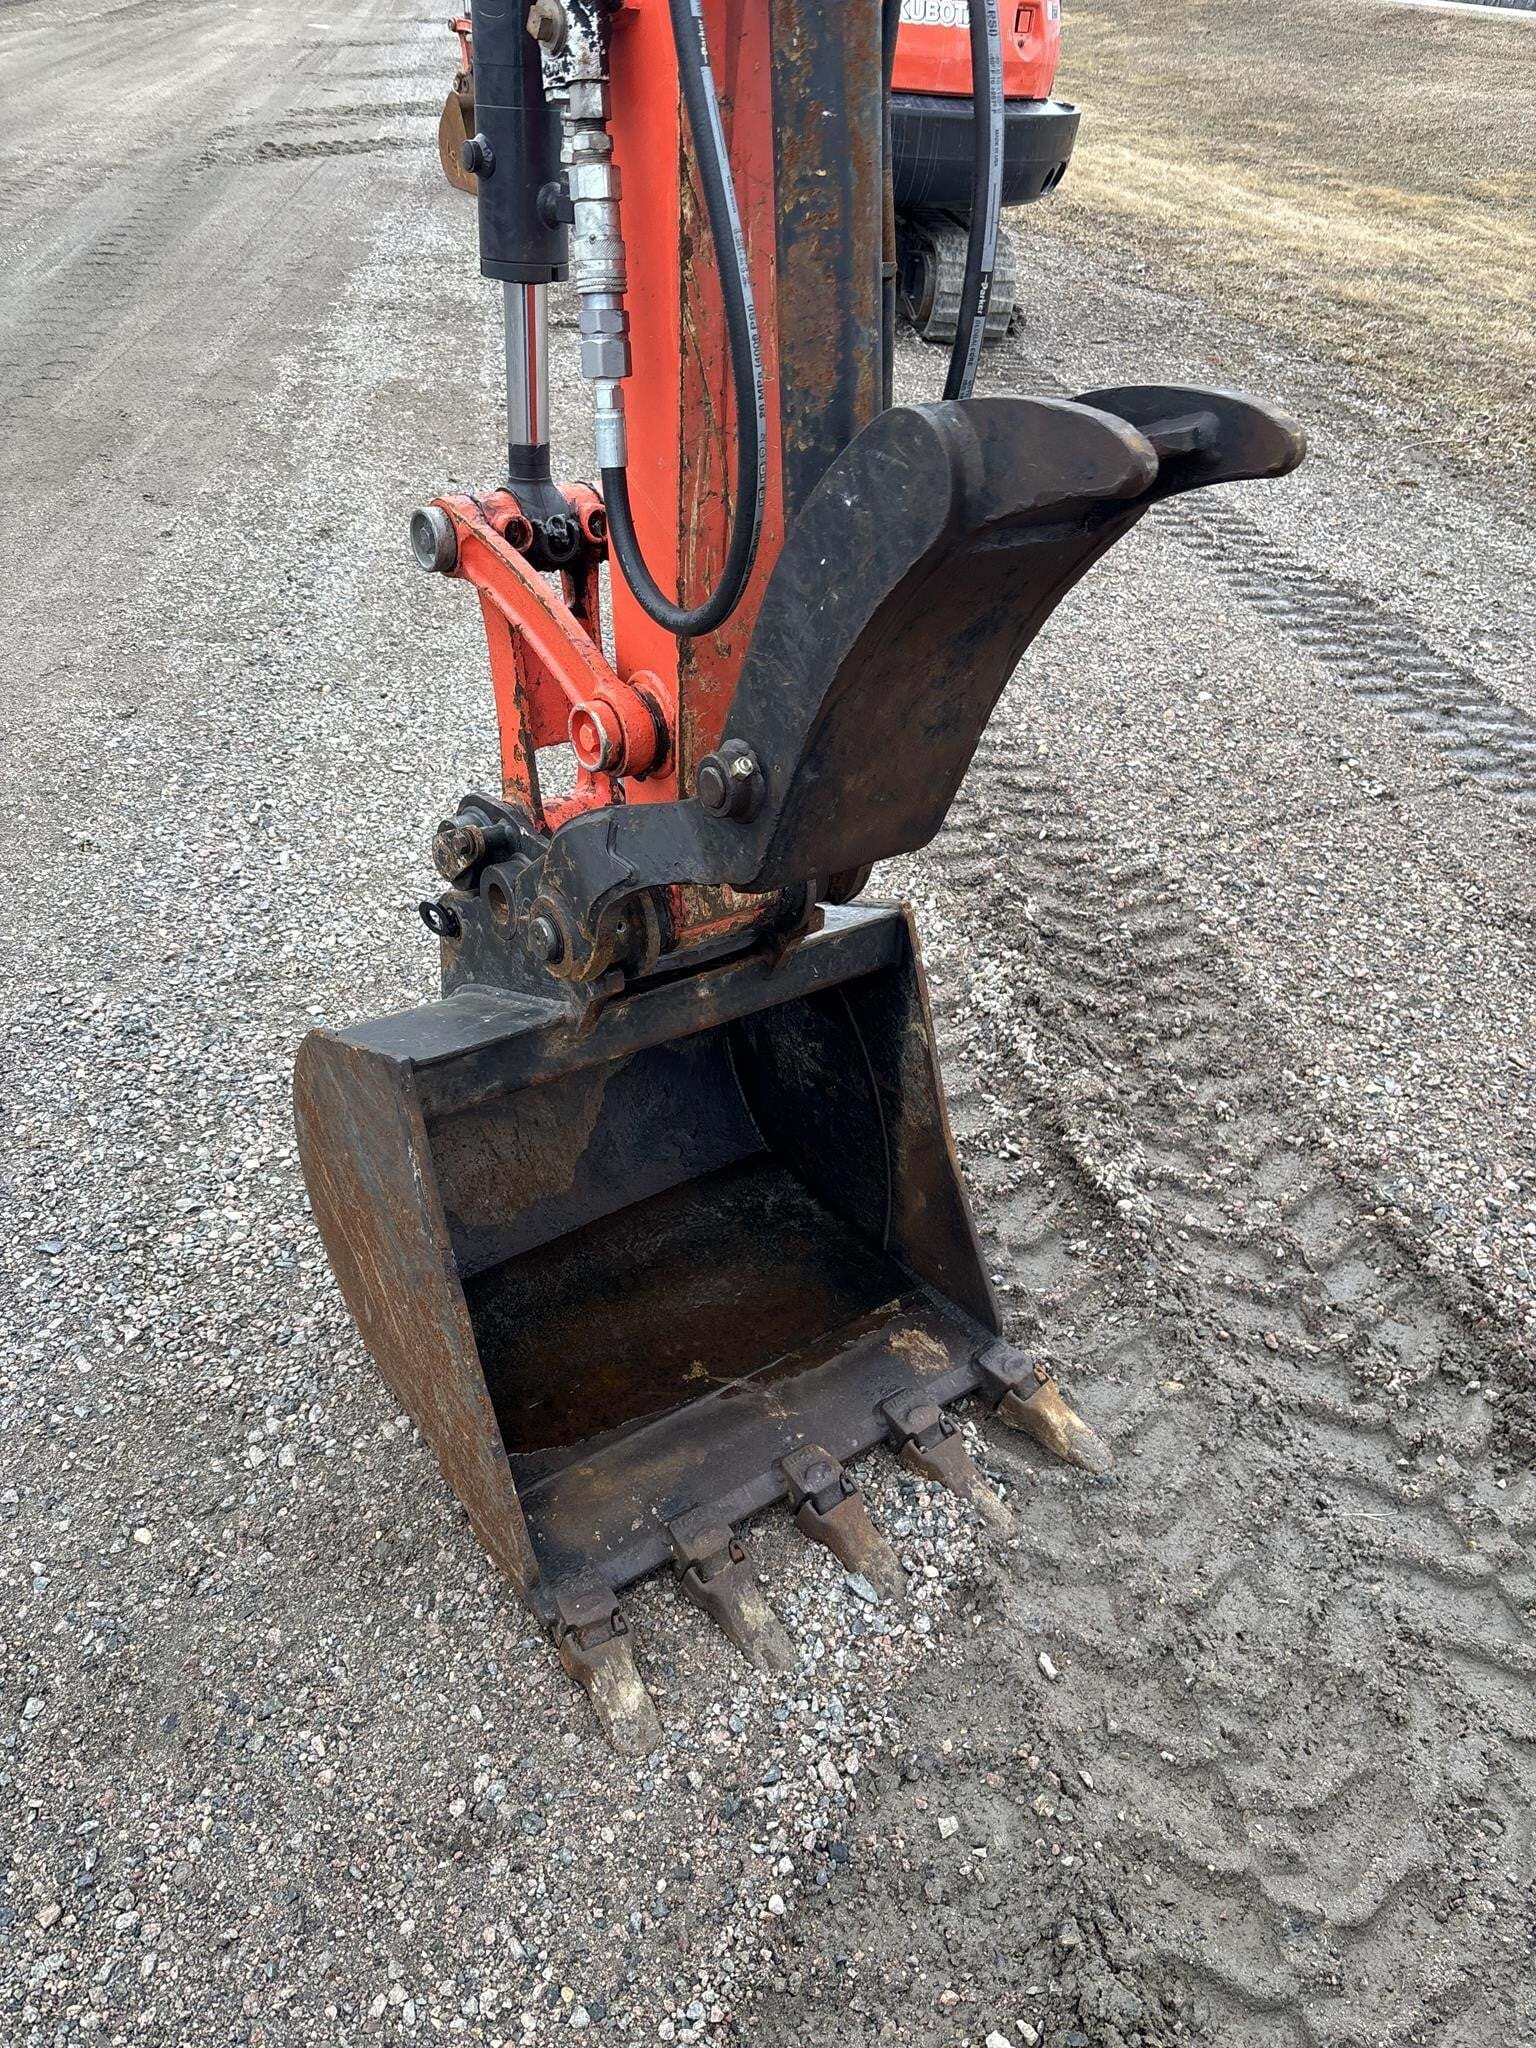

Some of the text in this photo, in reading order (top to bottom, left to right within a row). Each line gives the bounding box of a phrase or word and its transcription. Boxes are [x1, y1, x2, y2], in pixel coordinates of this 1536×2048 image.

[900, 0, 970, 25] KUBOT
[698, 18, 708, 56] Parker
[977, 282, 989, 314] Parker
